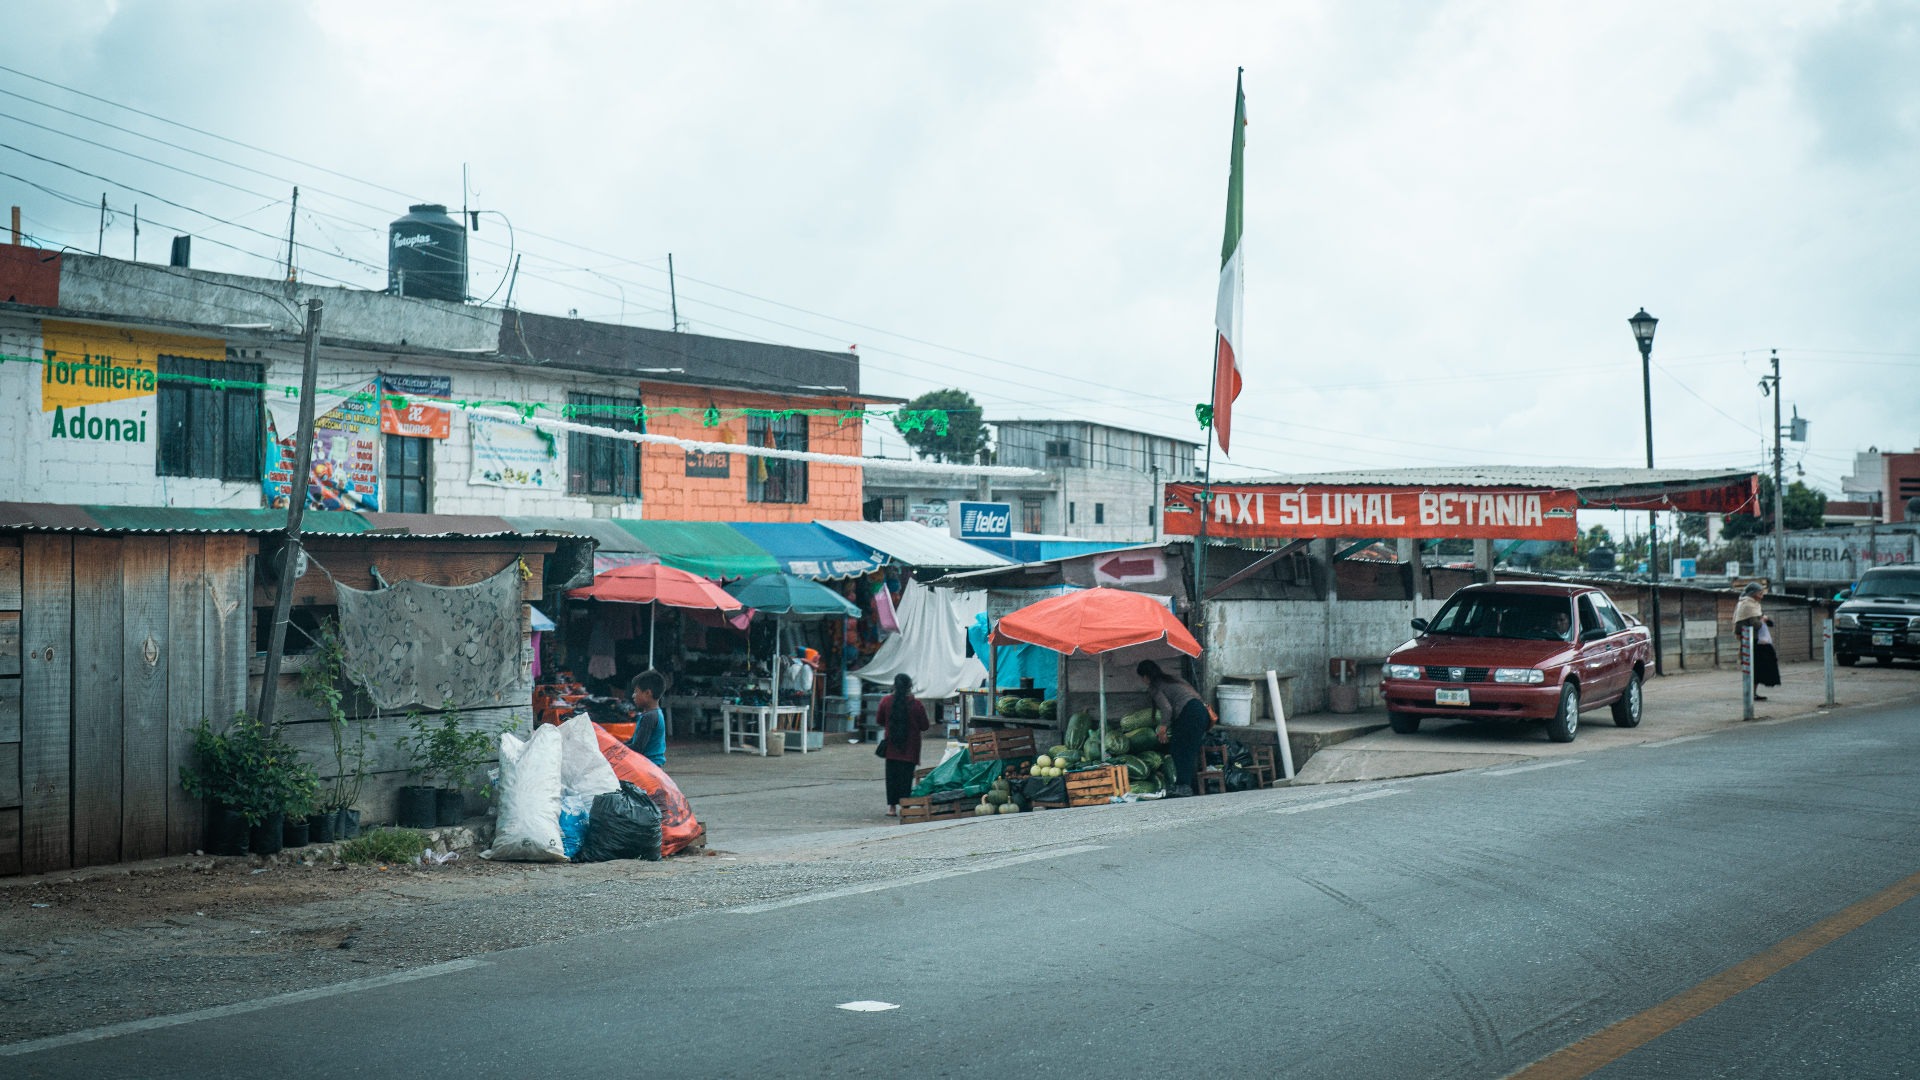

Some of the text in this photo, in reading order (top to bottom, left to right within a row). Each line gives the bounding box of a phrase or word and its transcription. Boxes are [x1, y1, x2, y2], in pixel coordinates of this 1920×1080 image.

[697, 453, 727, 468] TRUPER
[1420, 492, 1543, 527] BETANIA
[974, 510, 1010, 533] telcel
[1758, 546, 1851, 562] CANICERIA
